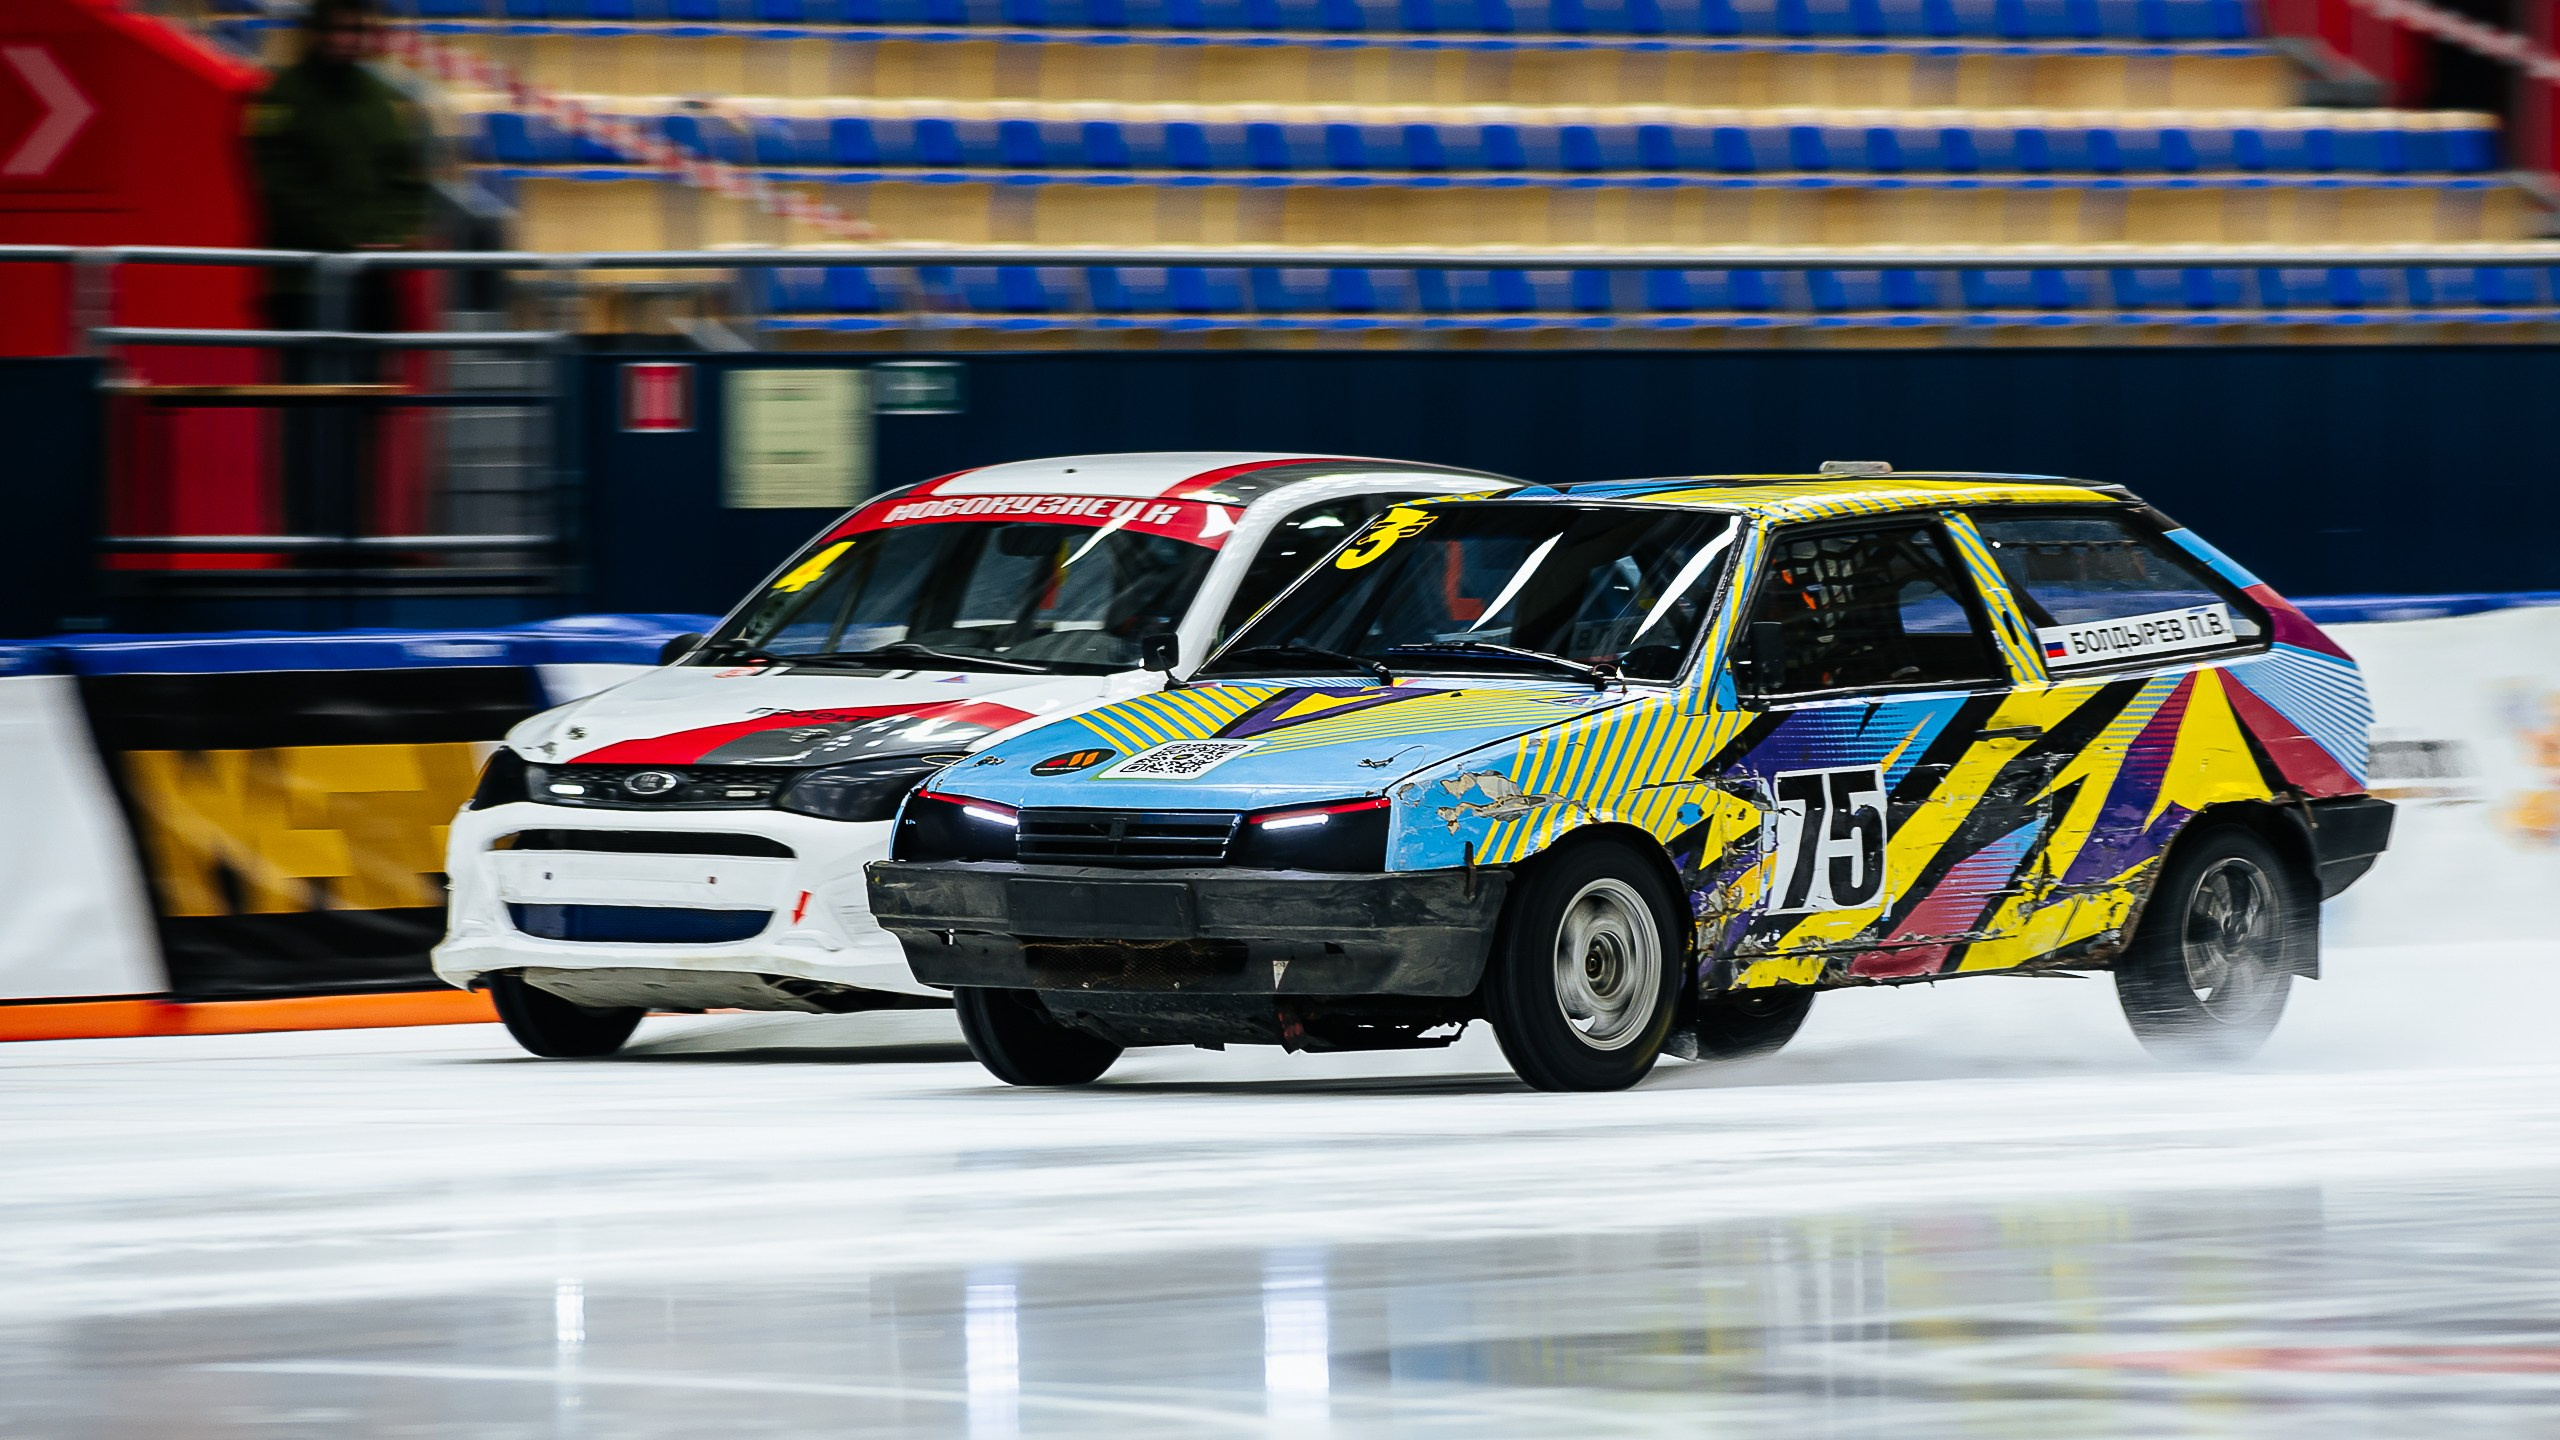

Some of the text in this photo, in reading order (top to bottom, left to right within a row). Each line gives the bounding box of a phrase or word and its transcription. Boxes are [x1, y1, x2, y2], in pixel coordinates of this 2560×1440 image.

[882, 495, 1181, 525] НОВОКУЗНЕЦК
[2070, 618, 2185, 655] БОЛДЫРЕВ
[1777, 769, 1884, 910] 75
